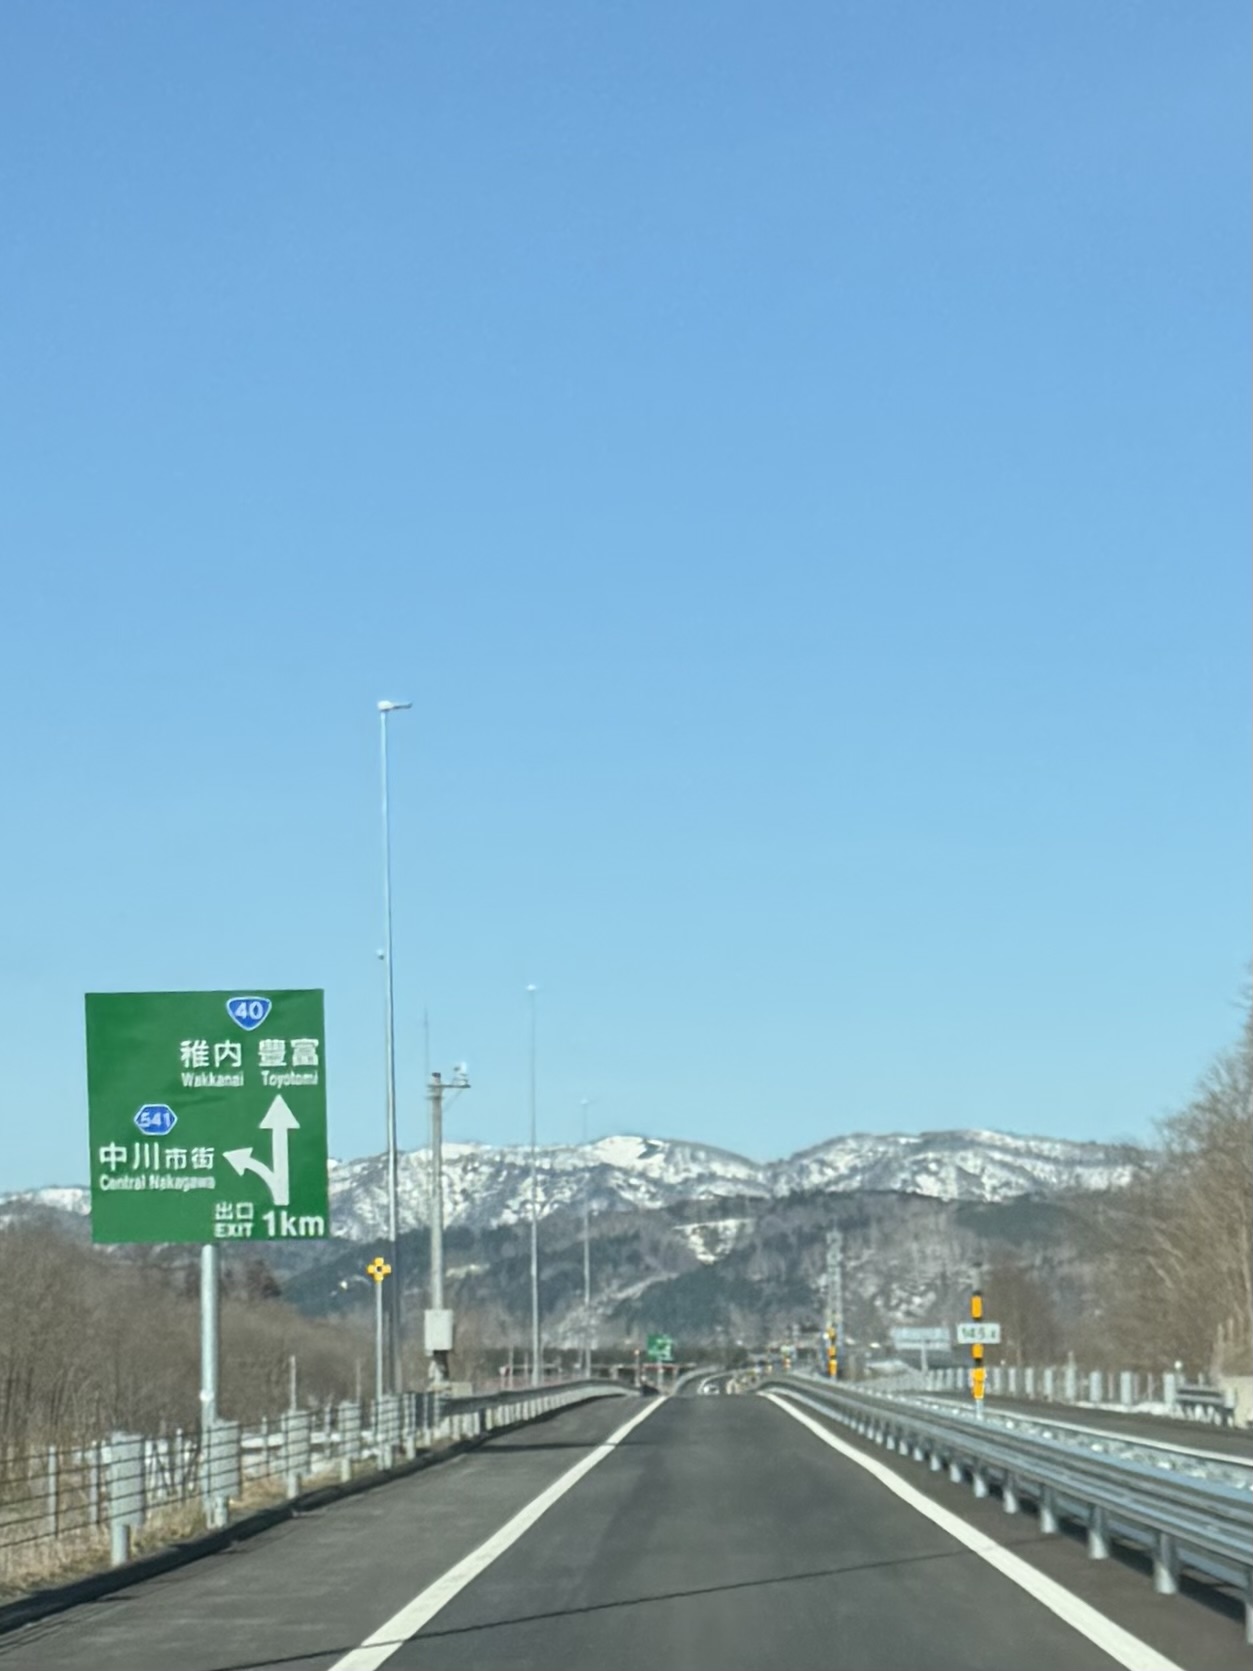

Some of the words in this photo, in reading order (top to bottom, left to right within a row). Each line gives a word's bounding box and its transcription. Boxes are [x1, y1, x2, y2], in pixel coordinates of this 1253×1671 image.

[235, 1001, 264, 1020] 40
[180, 1039, 243, 1068] 稚内
[258, 1038, 319, 1067] 豊富
[181, 1072, 244, 1088] Wakkanai
[261, 1070, 319, 1089] Toyotomi
[140, 1112, 171, 1128] 541
[99, 1141, 215, 1171] 中川市街
[100, 1175, 146, 1191] Central
[149, 1175, 216, 1192] Nakagawa
[215, 1202, 254, 1220] 出口
[214, 1222, 253, 1238] EXIT
[262, 1210, 325, 1238] 1km
